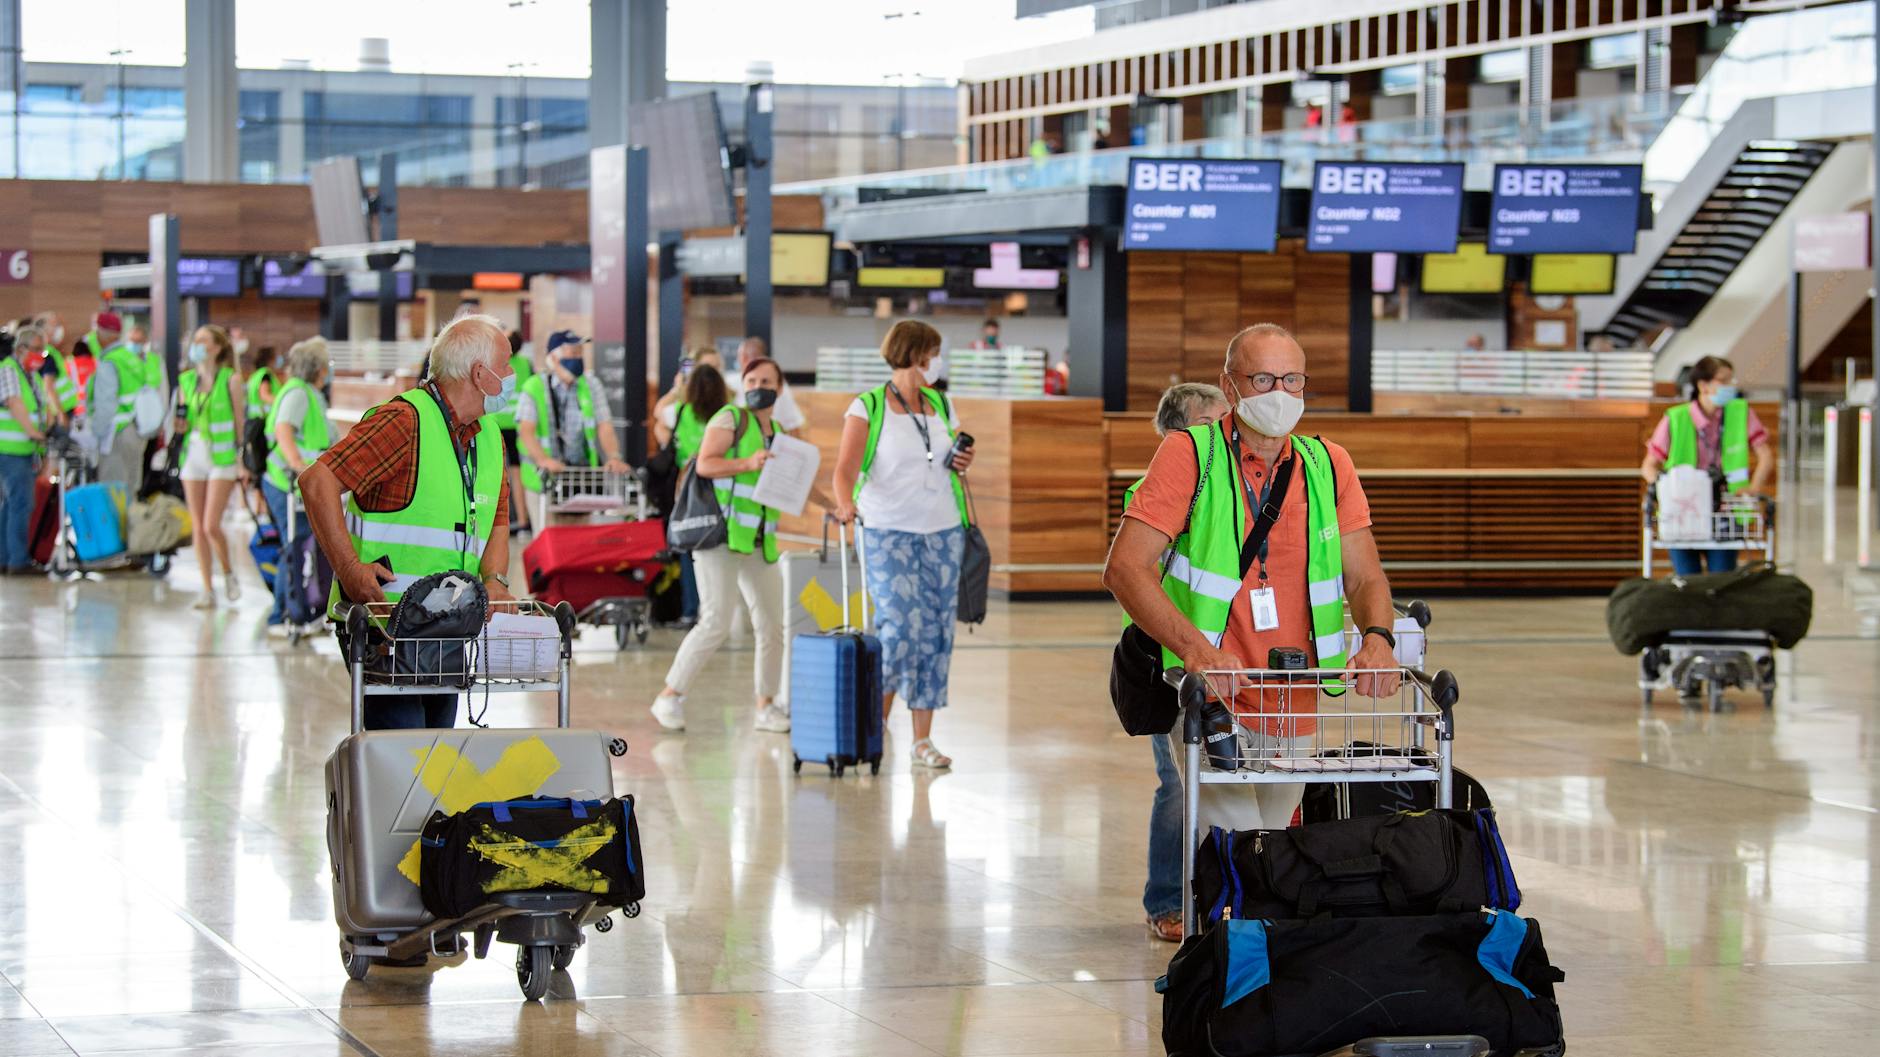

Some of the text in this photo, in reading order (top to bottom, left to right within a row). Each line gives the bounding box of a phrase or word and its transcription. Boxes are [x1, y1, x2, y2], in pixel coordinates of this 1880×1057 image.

[1134, 163, 1203, 191] BER
[1318, 166, 1386, 194] BER
[1499, 169, 1566, 196] BER
[1133, 203, 1185, 218] Counter
[1317, 206, 1369, 220] Counter
[1497, 208, 1549, 223] Counter
[8, 250, 30, 280] 6
